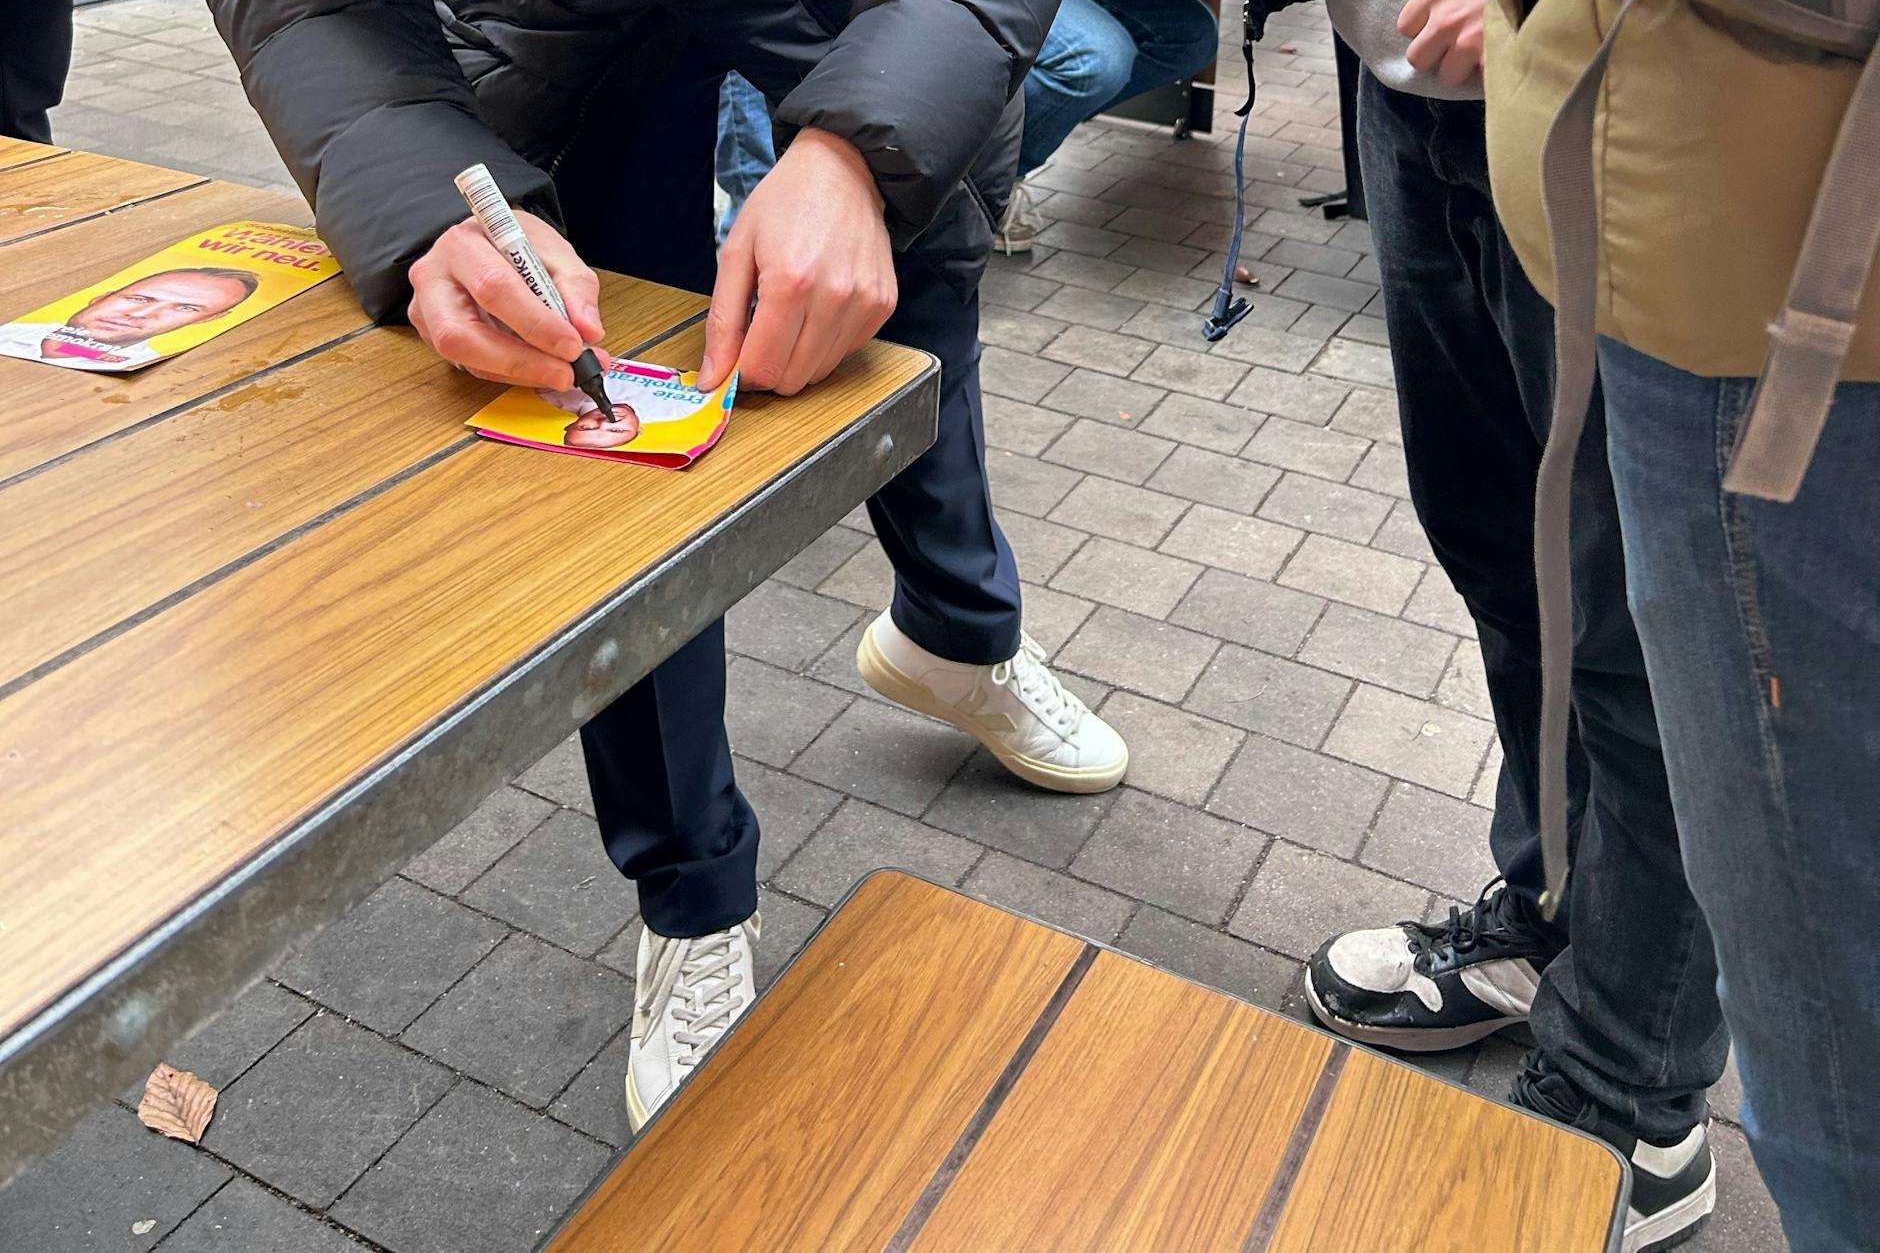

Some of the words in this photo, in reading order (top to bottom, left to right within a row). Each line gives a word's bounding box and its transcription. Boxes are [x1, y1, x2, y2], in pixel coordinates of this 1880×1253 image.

[199, 239, 255, 254] wir
[250, 249, 320, 271] neu.
[652, 389, 706, 404] Freie
